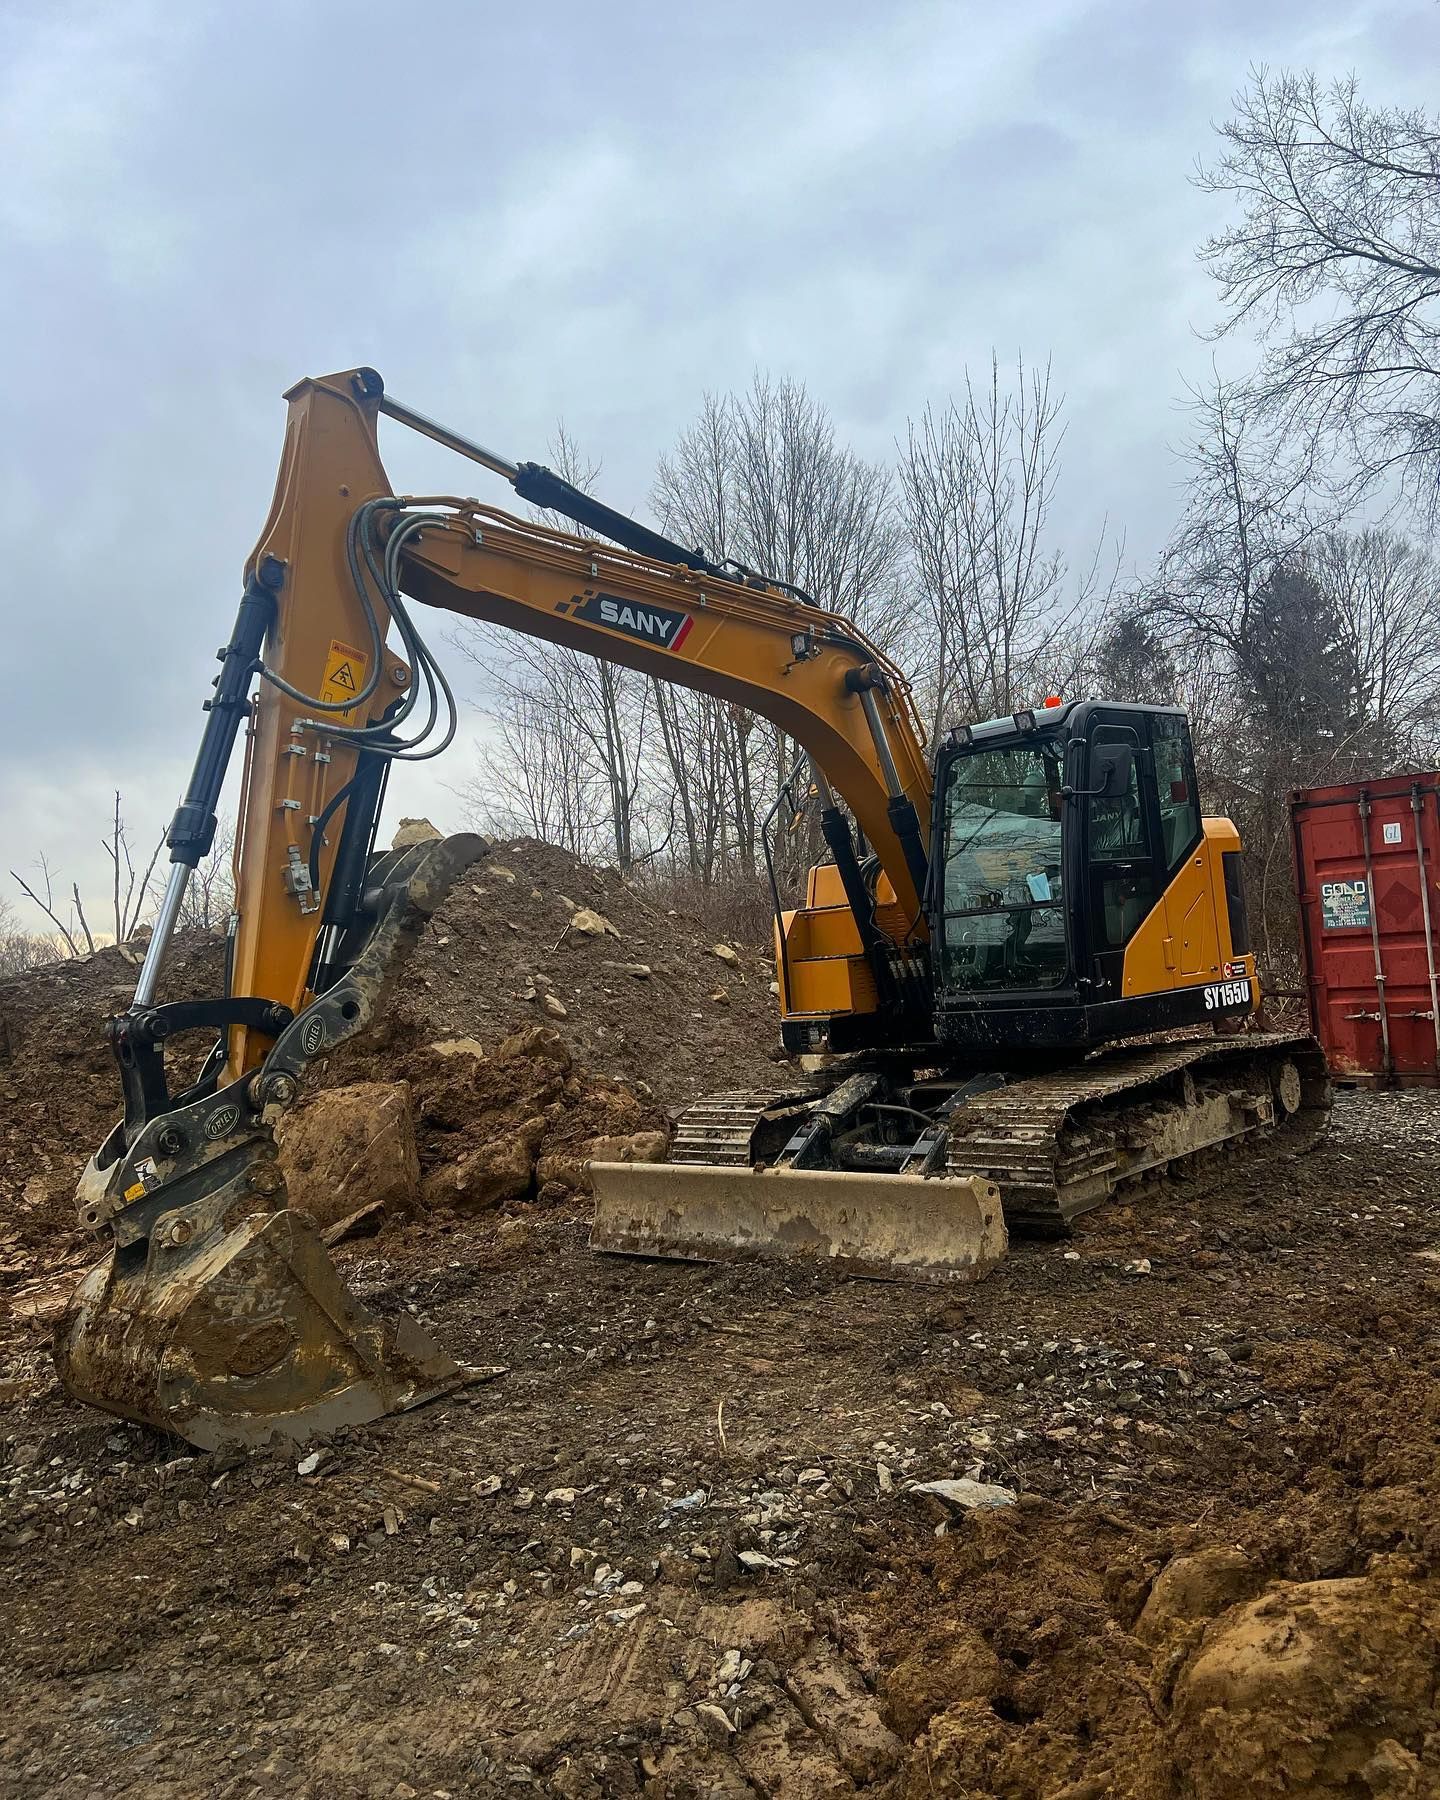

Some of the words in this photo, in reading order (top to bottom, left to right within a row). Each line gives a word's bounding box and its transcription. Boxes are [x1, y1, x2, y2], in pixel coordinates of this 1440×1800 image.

[600, 599, 672, 638] SANY
[1322, 881, 1366, 897] GOLD
[1203, 981, 1250, 1010] SY155U
[307, 1024, 321, 1050] ORIEL
[211, 1111, 233, 1134] ORIEL
